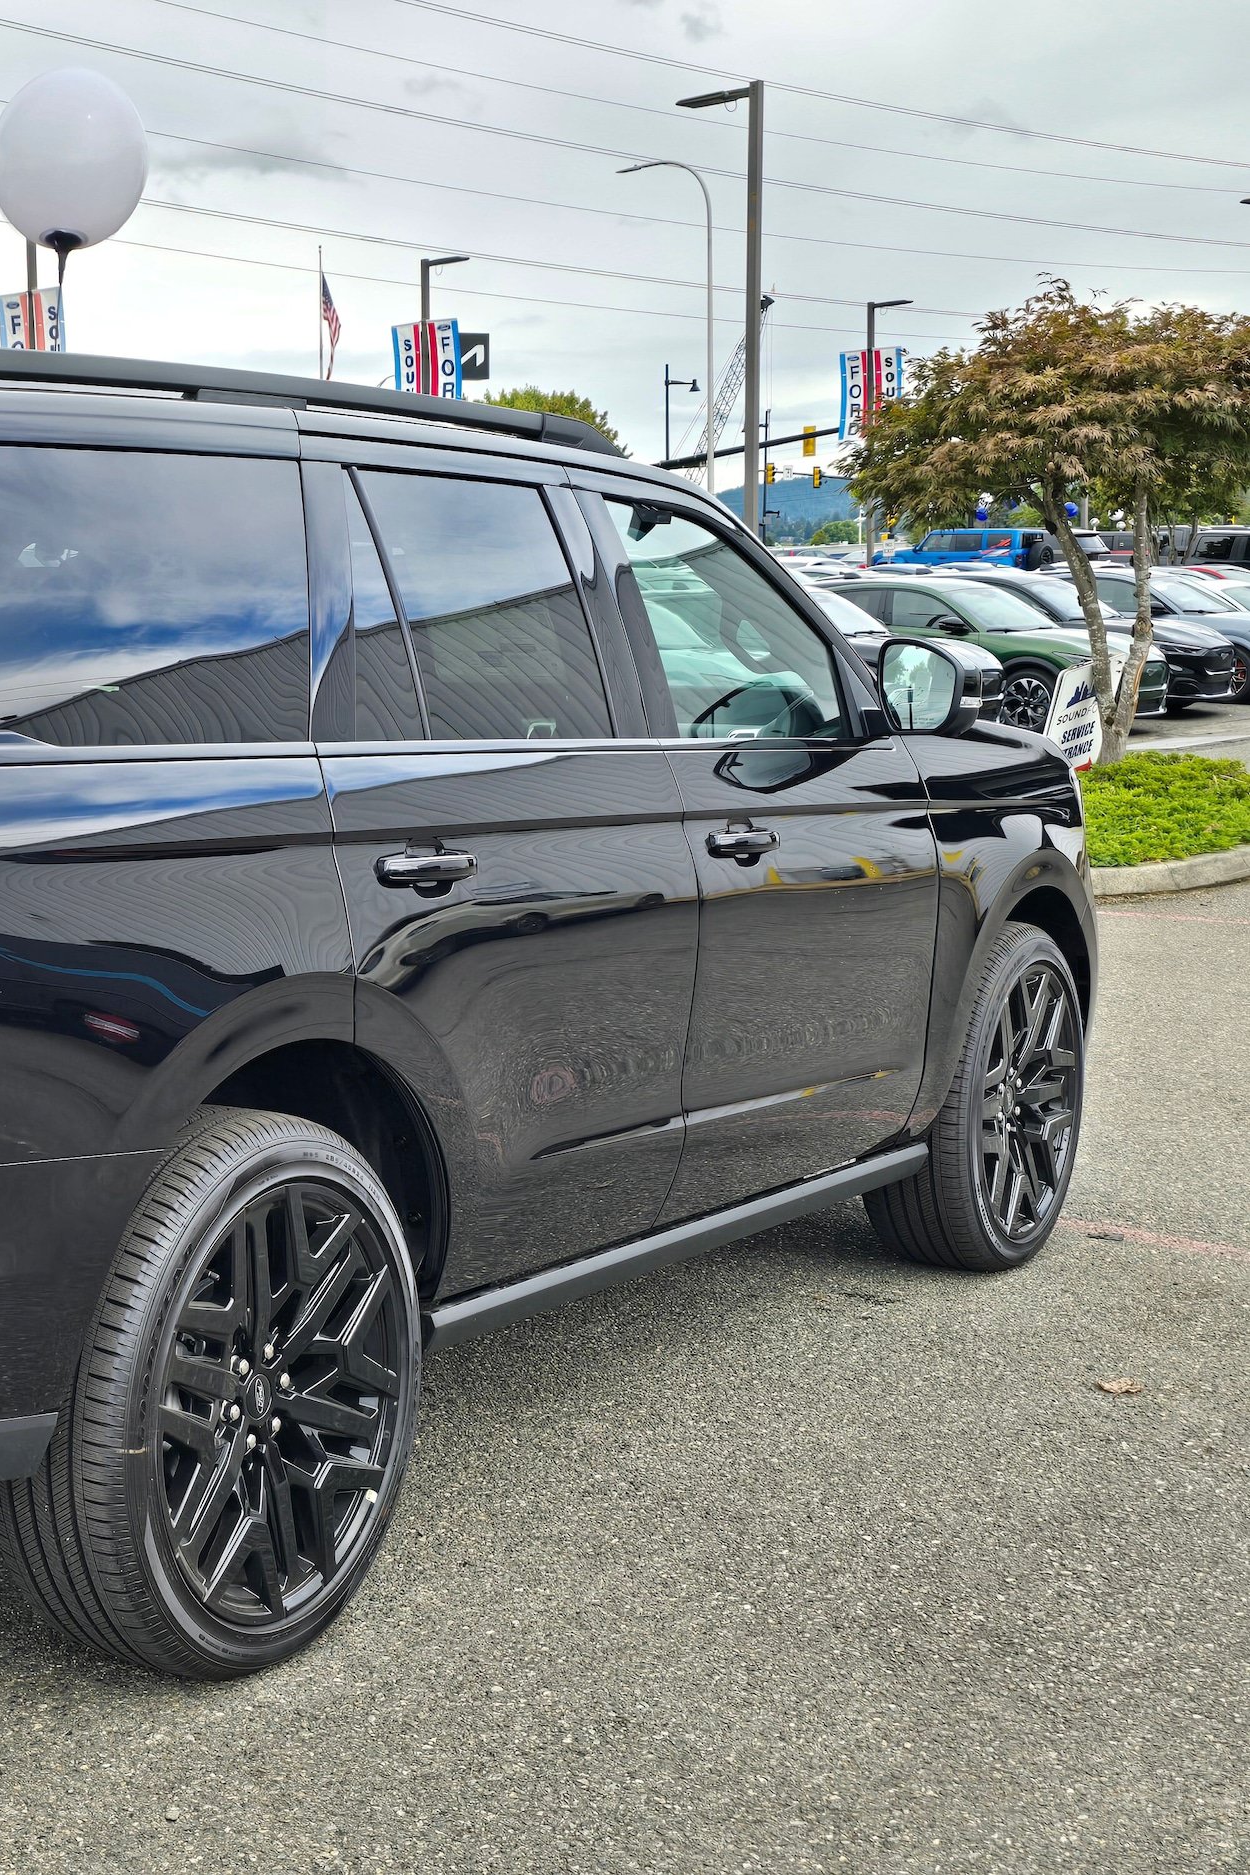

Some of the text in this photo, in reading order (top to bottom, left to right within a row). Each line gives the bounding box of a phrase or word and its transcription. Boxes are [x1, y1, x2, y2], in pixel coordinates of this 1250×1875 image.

[403, 339, 415, 392] SOU
[441, 336, 455, 398] FOR
[884, 357, 895, 397] SOU
[1061, 720, 1096, 745] SERVICE
[1063, 738, 1094, 759] TRANCE
